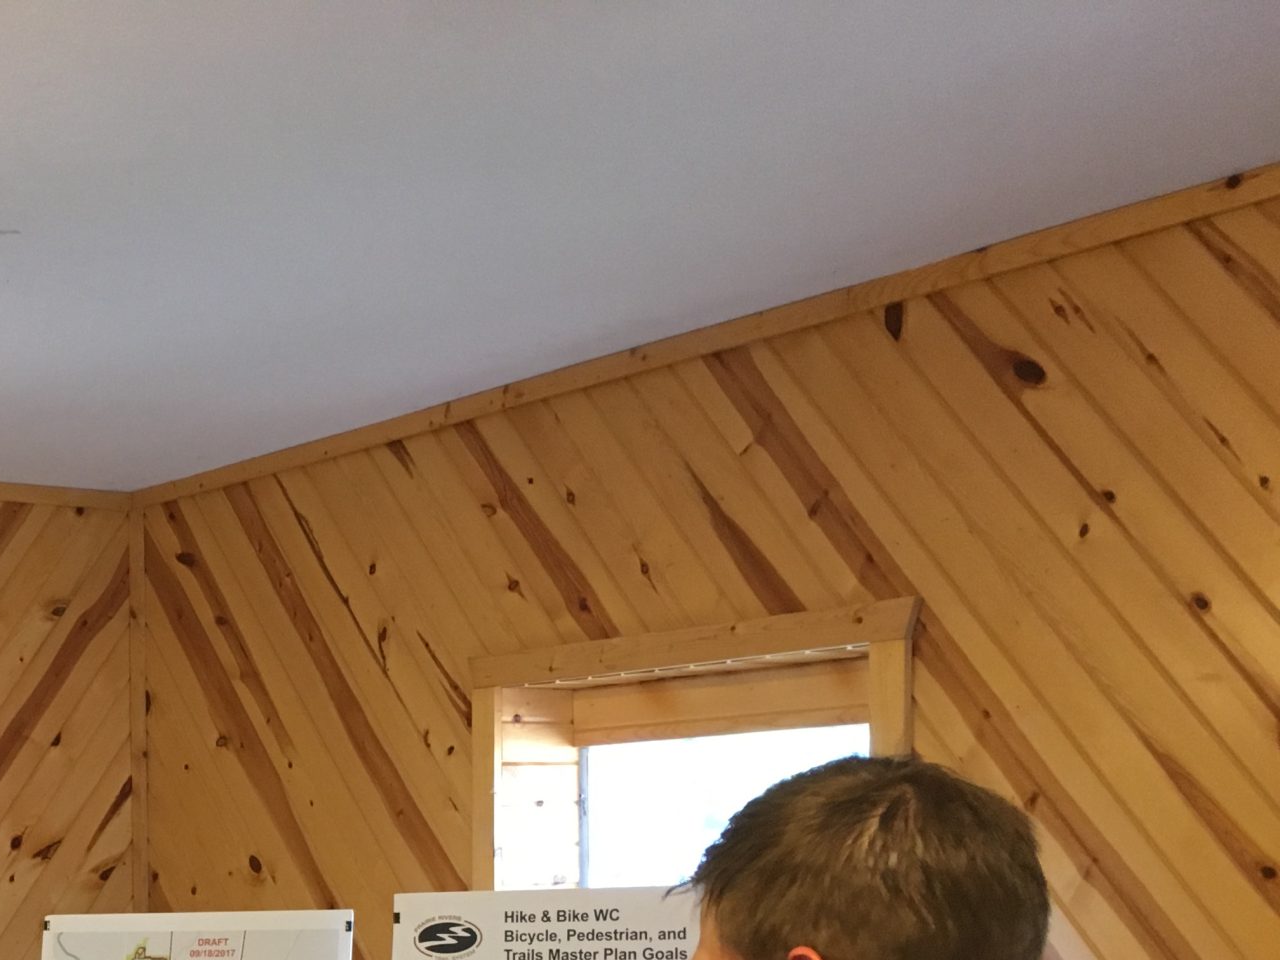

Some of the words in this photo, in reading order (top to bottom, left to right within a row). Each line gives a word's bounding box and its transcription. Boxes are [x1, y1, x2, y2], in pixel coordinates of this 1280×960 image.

[504, 910, 536, 923] Hike
[541, 910, 552, 922] &
[556, 909, 589, 922] Bike
[593, 908, 620, 921] WC
[197, 938, 229, 947] DRAFT
[504, 929, 562, 945] Bicycle,
[566, 928, 653, 943] Pedestrian,
[657, 926, 687, 940] and
[504, 948, 543, 960] Trails
[548, 948, 599, 960] Master
[604, 947, 637, 960] Plan
[642, 947, 688, 960] Goals
